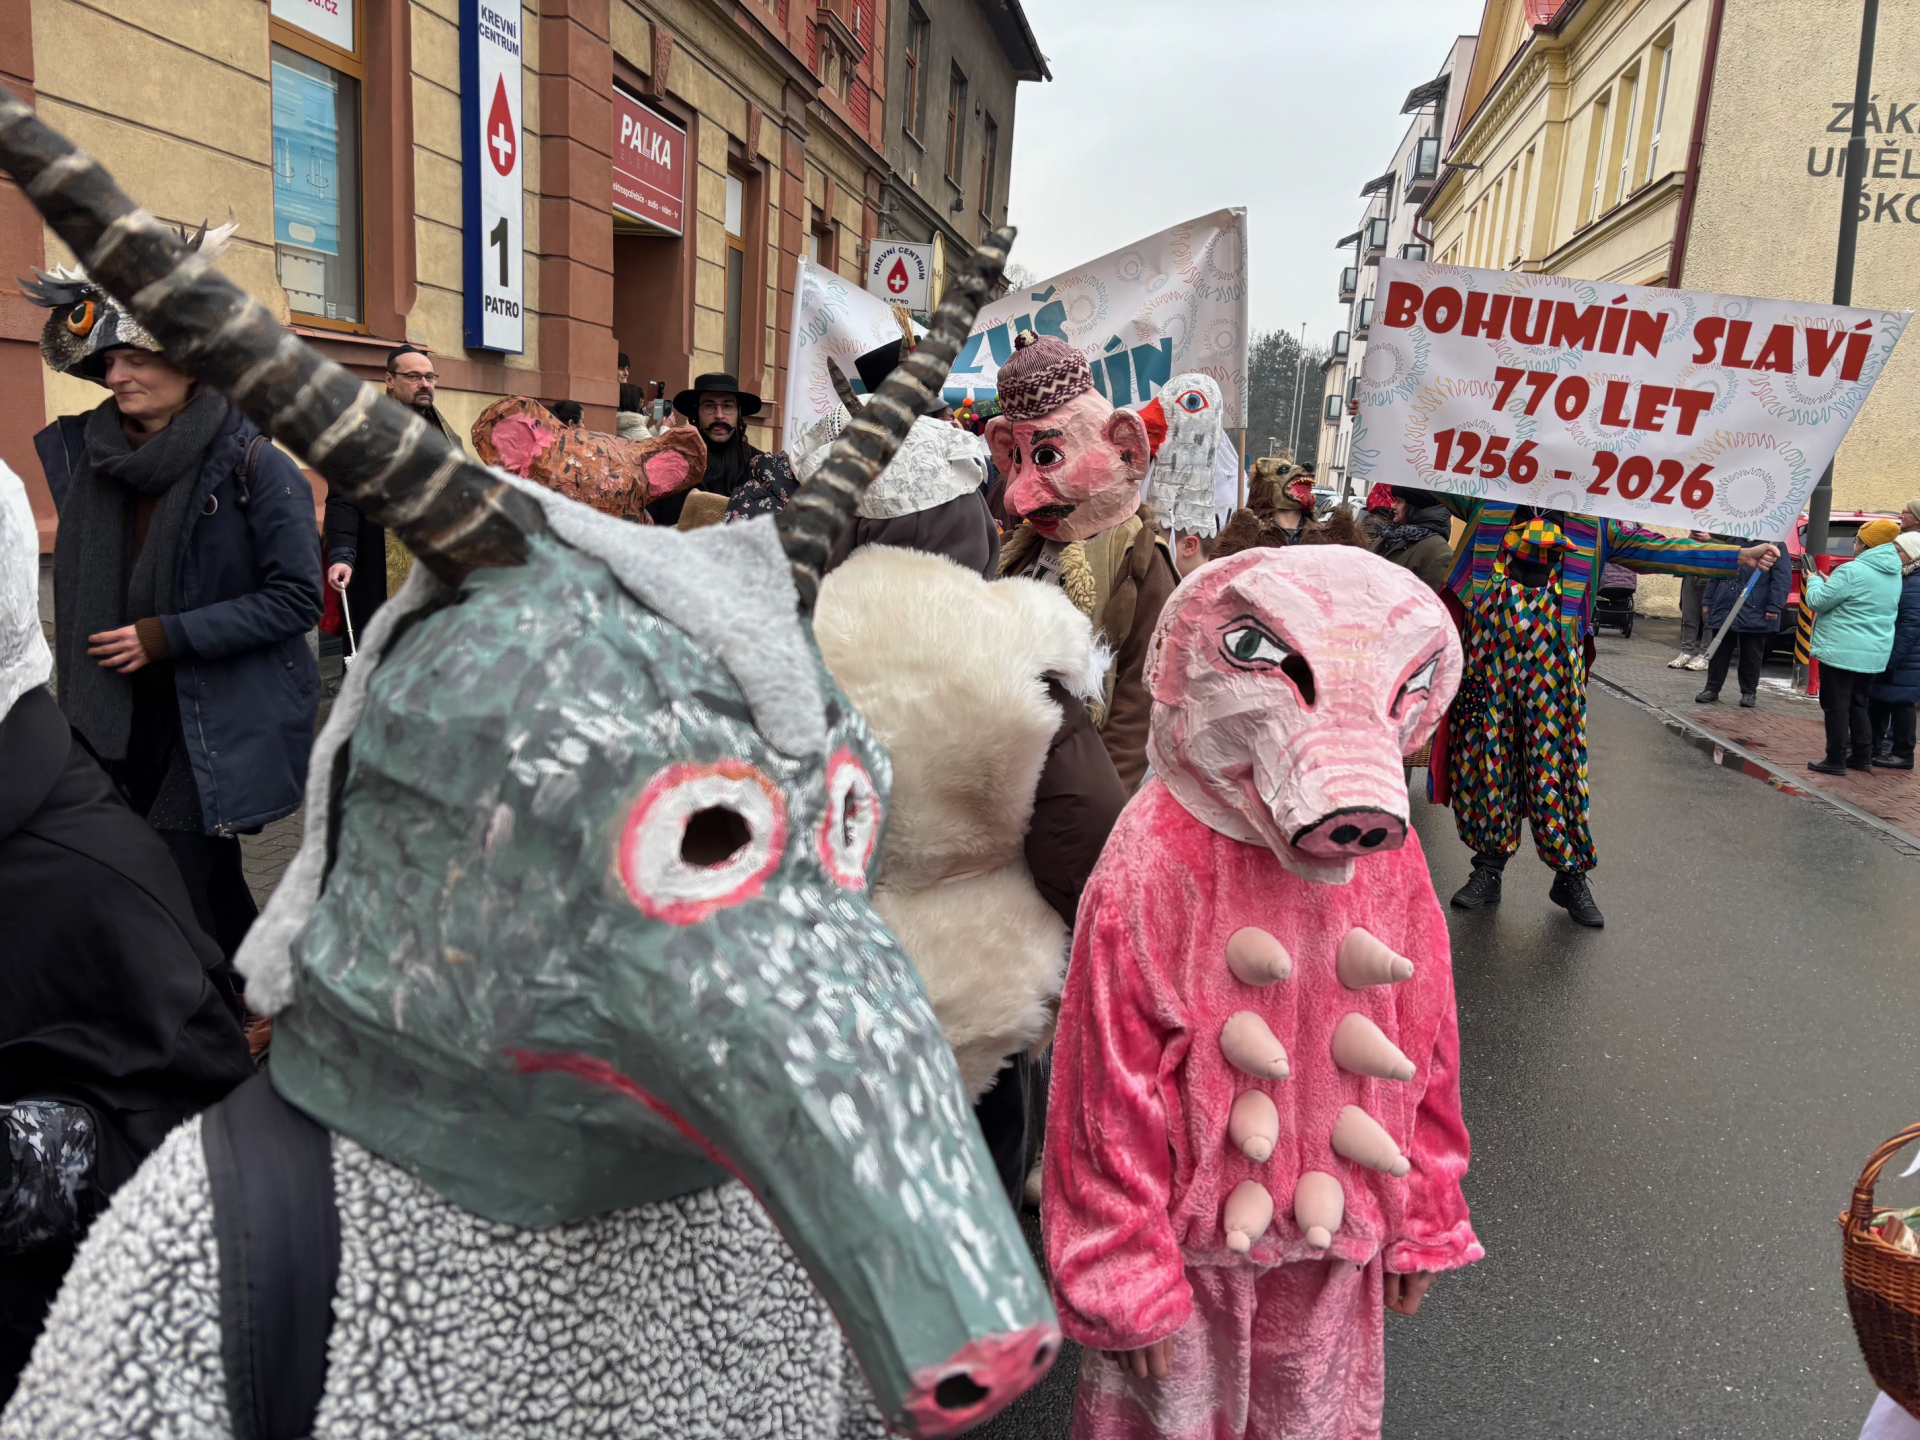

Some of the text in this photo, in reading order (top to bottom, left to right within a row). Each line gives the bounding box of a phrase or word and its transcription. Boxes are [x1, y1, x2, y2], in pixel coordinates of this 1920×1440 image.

[479, 22, 519, 57] CENTRUM
[481, 4, 517, 39] KREVNÍ
[1826, 94, 1920, 133] ZÁK
[620, 113, 671, 170] PALKA
[647, 199, 658, 210] audio
[661, 205, 672, 216] video
[490, 216, 508, 288] 1
[873, 246, 896, 275] KREVNÍ
[898, 246, 925, 280] CENTRUM
[485, 294, 519, 318] PATRO
[1384, 281, 1873, 382] BOHUMÍN SLAVÍ
[1492, 366, 1715, 436] 770 LET
[1433, 428, 1715, 510] 1256 - 2026
